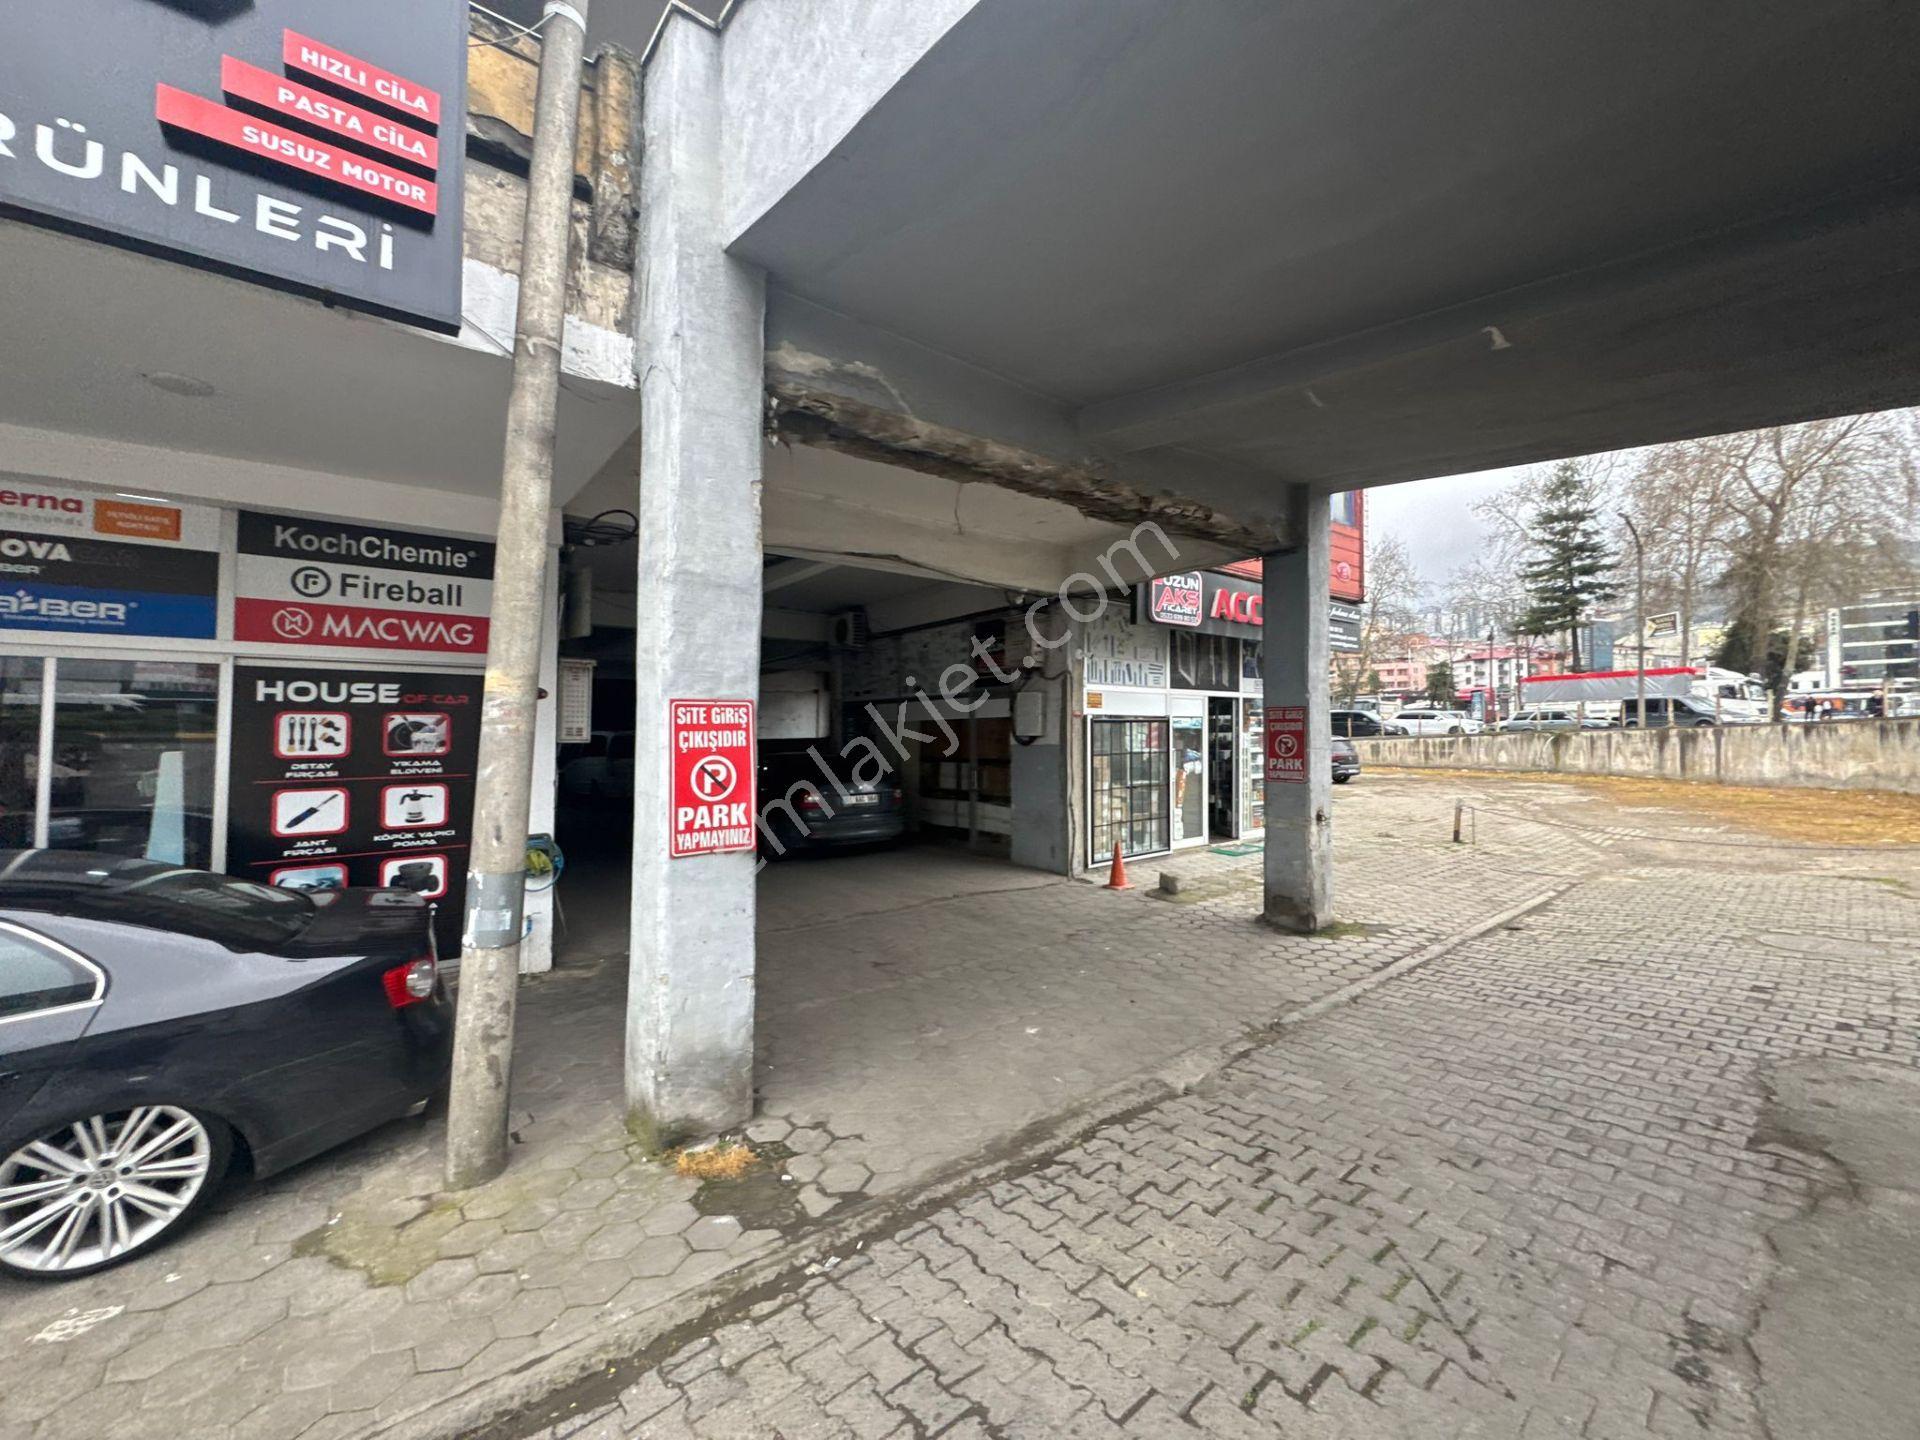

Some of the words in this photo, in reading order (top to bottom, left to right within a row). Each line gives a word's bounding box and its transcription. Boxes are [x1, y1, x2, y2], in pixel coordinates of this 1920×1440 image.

[300, 46, 367, 88] HIZLI
[374, 80, 430, 114] CİLA
[277, 86, 364, 133] PASTA
[373, 125, 427, 159] CİLA
[242, 125, 331, 170] SUSUZ
[341, 160, 426, 203] MOTOR
[0, 112, 394, 271] ÜNLERİ
[339, 573, 464, 608] Fireball
[1162, 574, 1199, 591] UZUN
[1154, 586, 1200, 612] AKS
[321, 613, 475, 647] MACWAG
[255, 680, 402, 704] HOUSE
[678, 729, 747, 753] ÇIKIŞIDIR
[290, 762, 334, 770] DETAY
[1269, 758, 1303, 770] PARK
[677, 802, 749, 831] PARK
[292, 838, 329, 848] JANT
[391, 838, 438, 848] POMPA
[676, 828, 751, 851] YAPMAYINIZ
